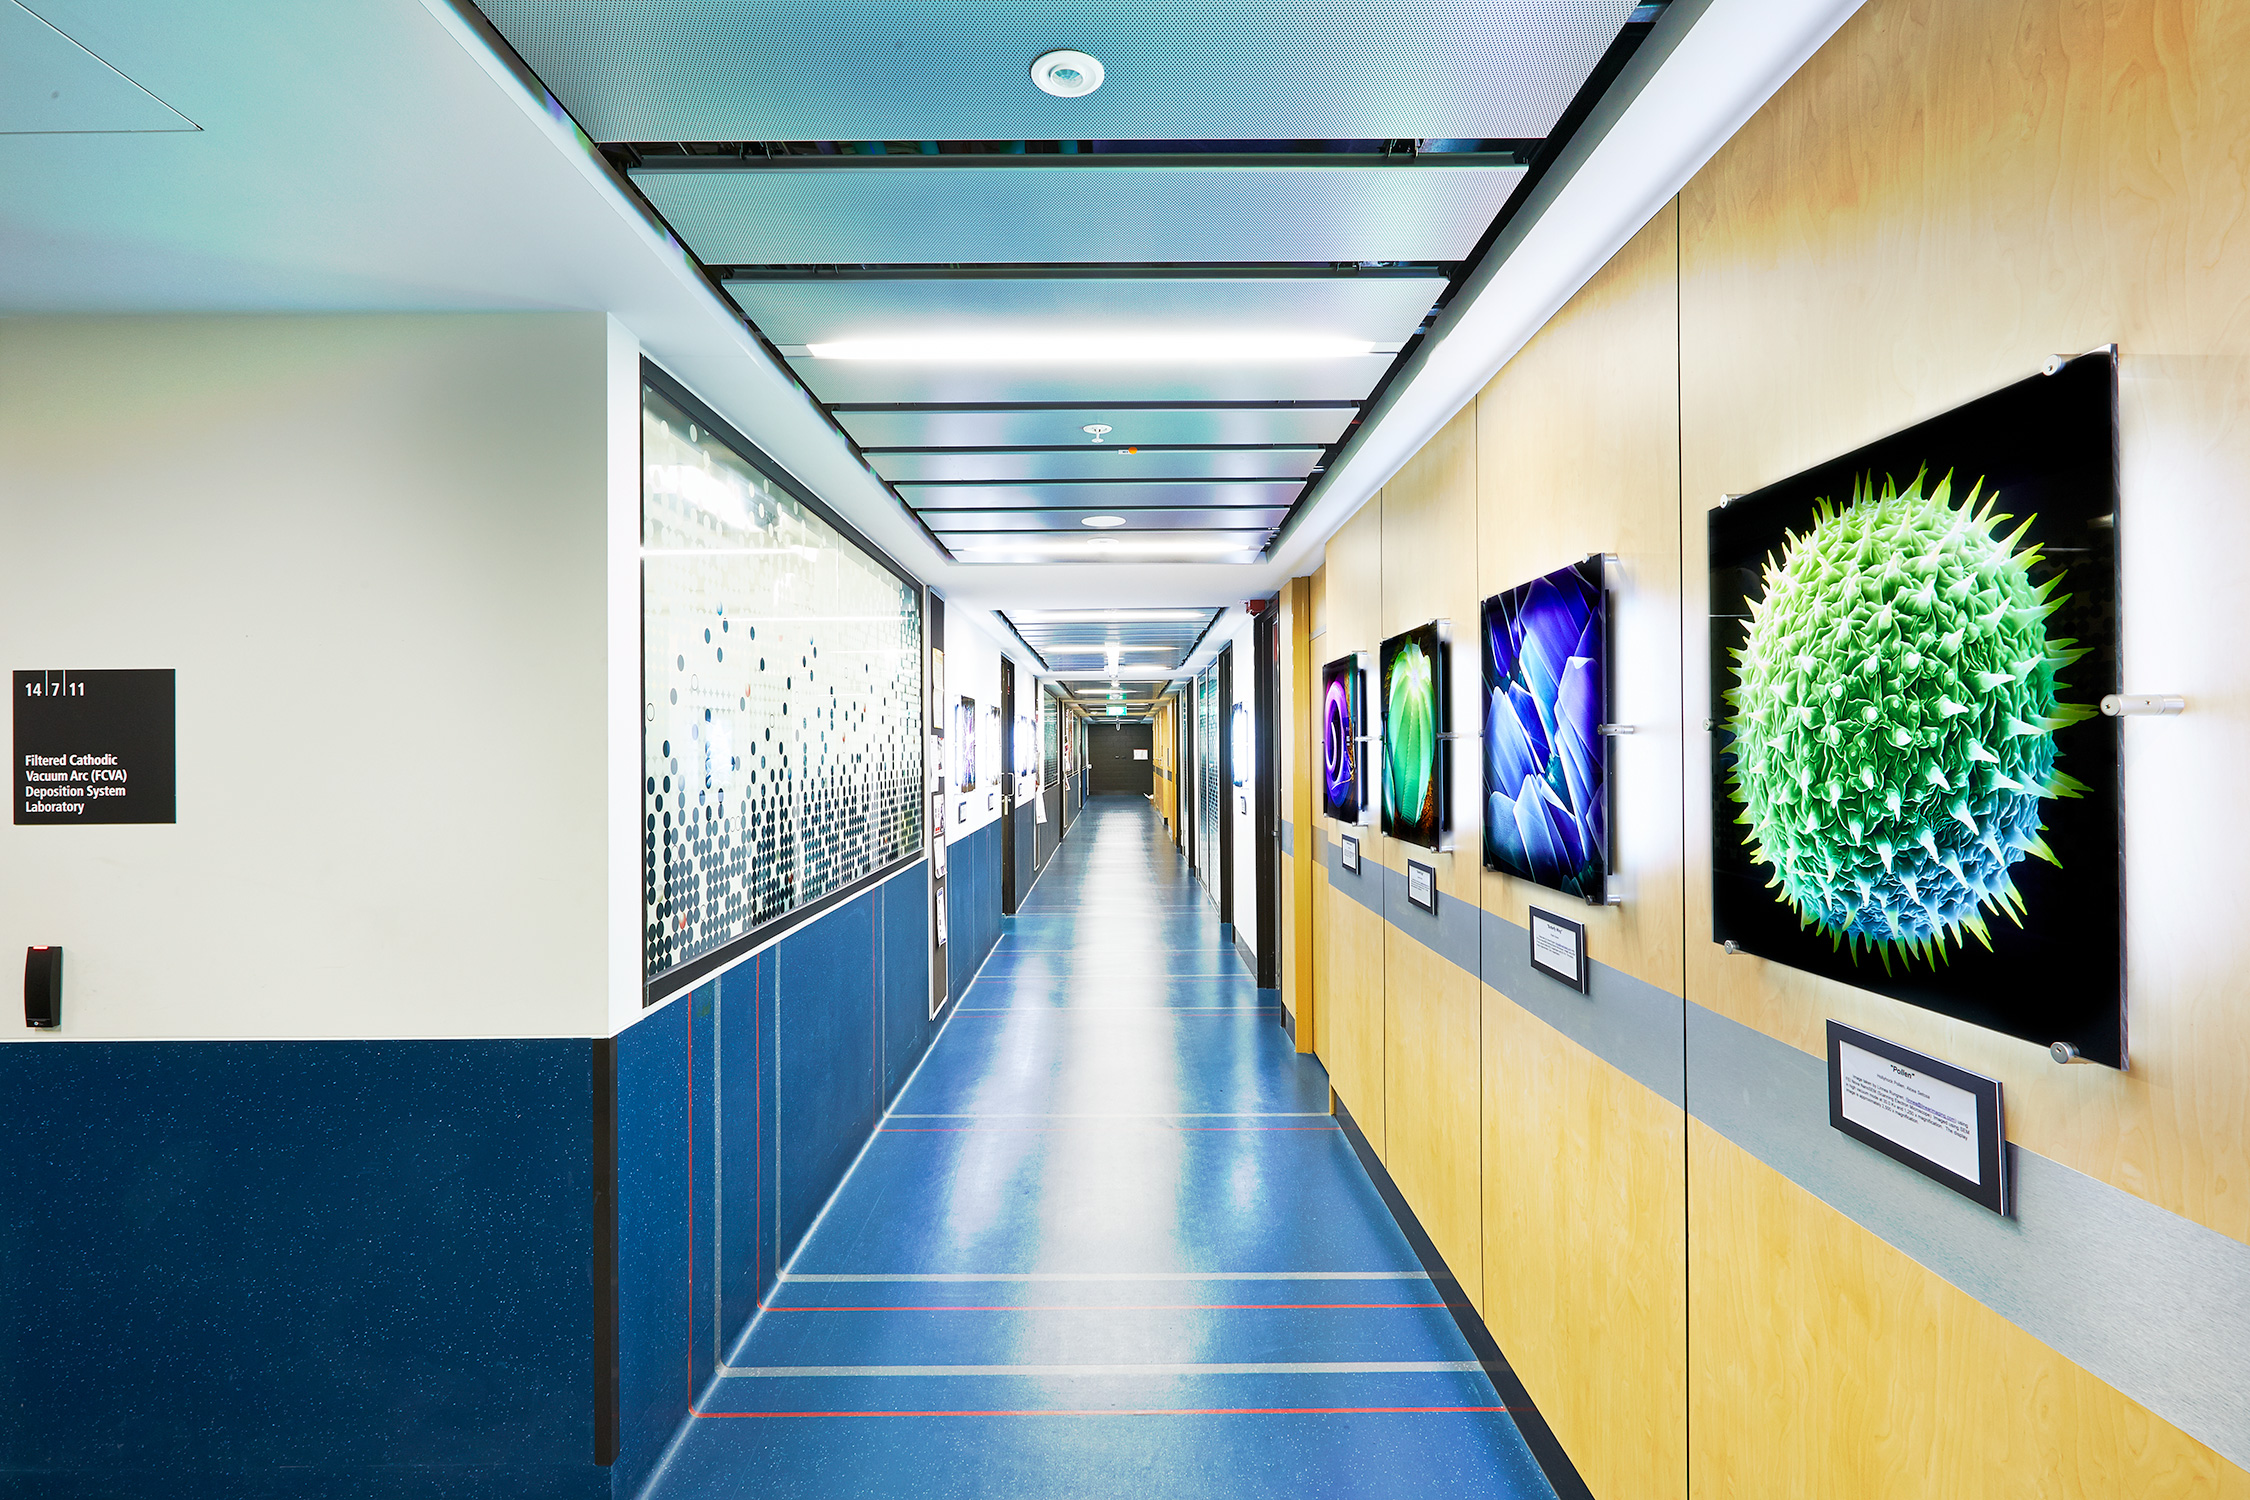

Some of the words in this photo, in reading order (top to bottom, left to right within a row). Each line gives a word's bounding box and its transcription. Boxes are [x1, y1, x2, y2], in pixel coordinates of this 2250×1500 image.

[25, 682, 42, 697] 14
[51, 682, 60, 697] 7
[69, 682, 85, 697] 11
[25, 754, 67, 766] Filtered
[69, 753, 118, 766] Cathodic
[25, 770, 68, 782] Vacuum
[70, 769, 89, 781] Arc
[91, 769, 128, 783] (FCVA)
[25, 785, 84, 800] Deposition
[86, 785, 126, 799] System
[25, 801, 85, 815] Laboratory
[1890, 1064, 1915, 1079] "Pollen"
